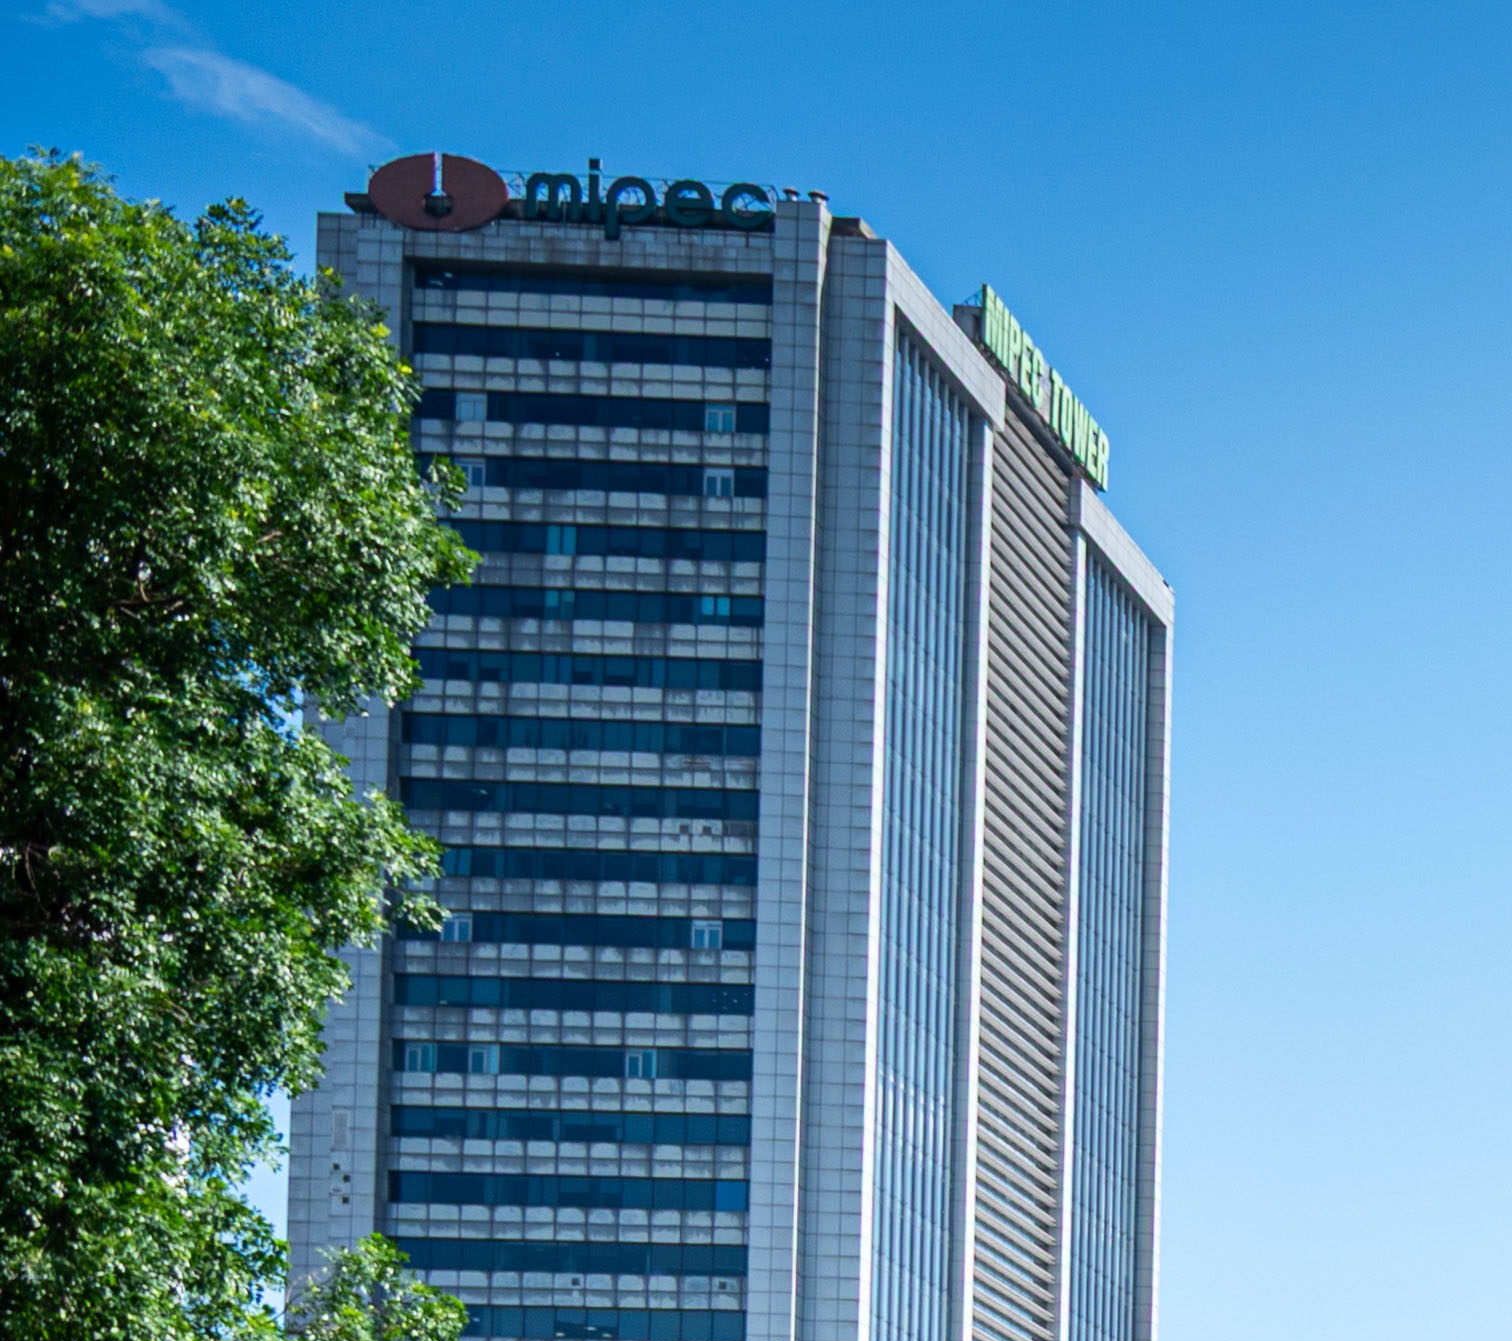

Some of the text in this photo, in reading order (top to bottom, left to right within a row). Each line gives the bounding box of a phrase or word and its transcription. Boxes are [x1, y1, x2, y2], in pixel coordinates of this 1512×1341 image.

[523, 158, 773, 240] mipec
[984, 284, 1110, 493] MIPEC TOWER
